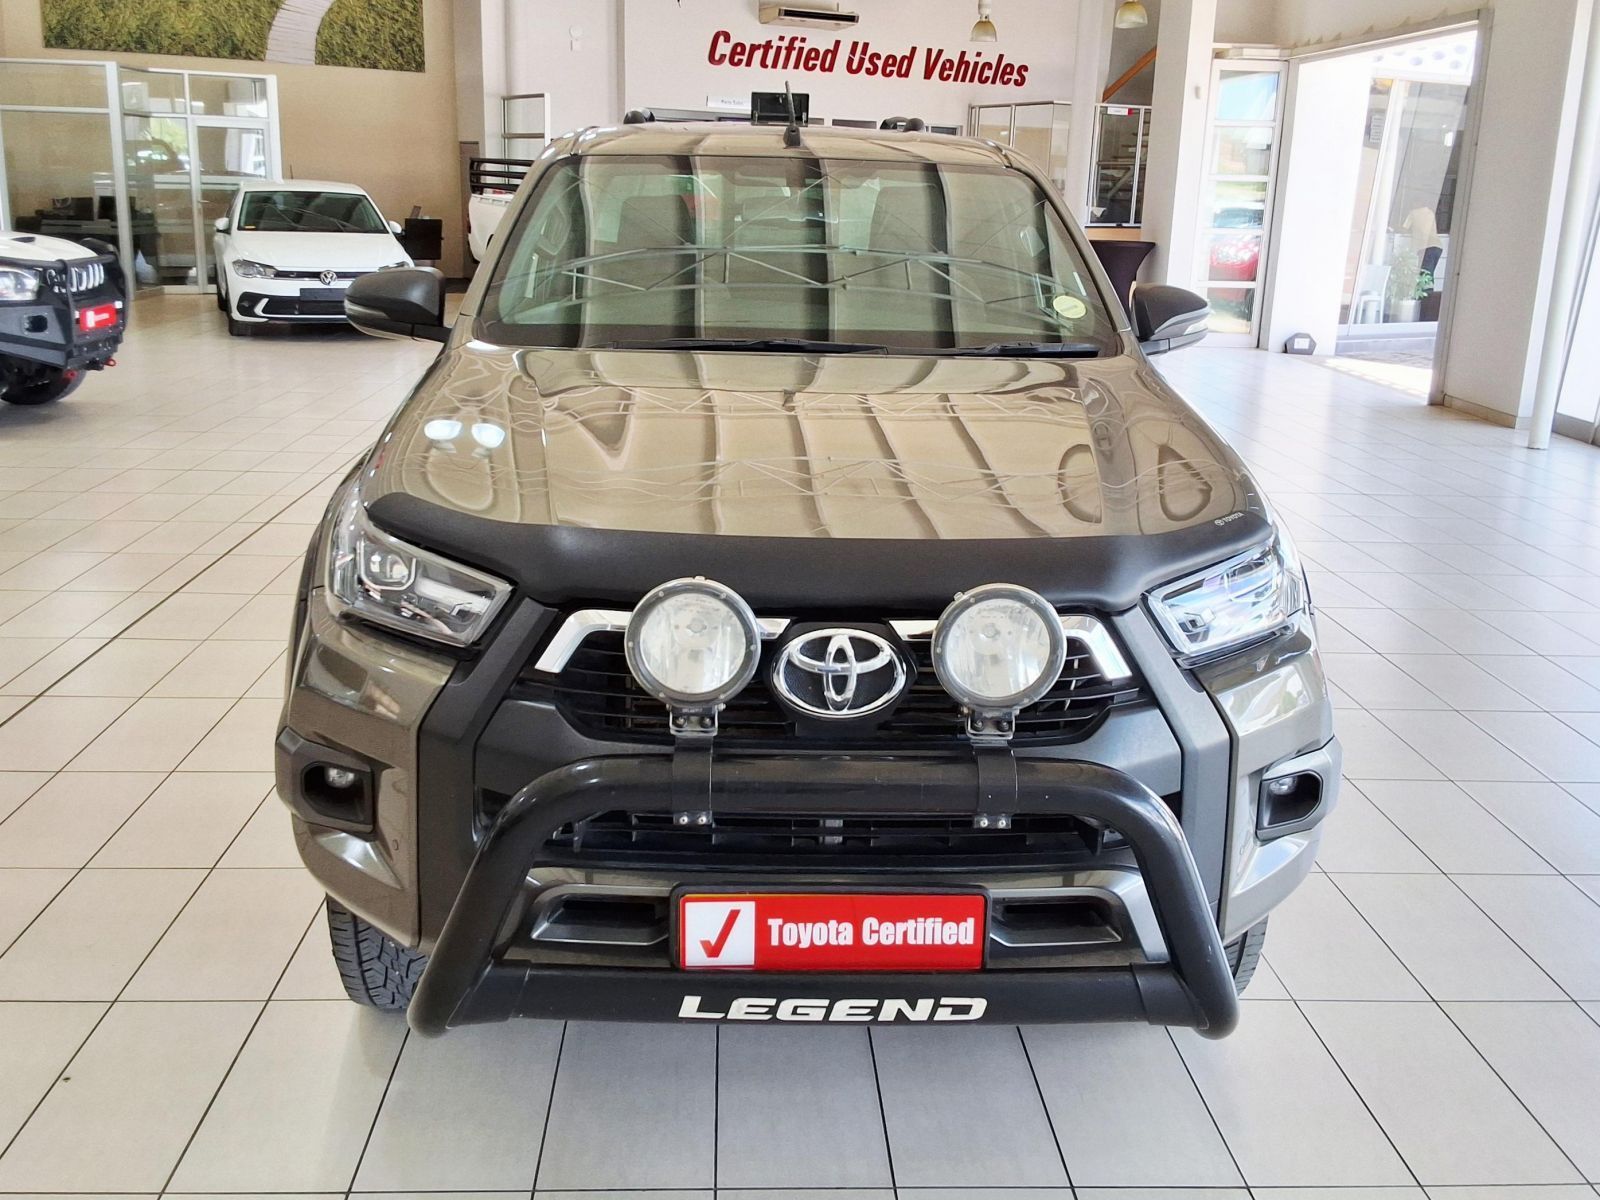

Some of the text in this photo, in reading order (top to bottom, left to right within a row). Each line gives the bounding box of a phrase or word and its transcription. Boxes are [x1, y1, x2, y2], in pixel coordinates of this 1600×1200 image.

[707, 30, 1029, 87] Certified Used Vehicles
[768, 917, 975, 948] Toyota Certified
[678, 995, 988, 1022] LEGEND
